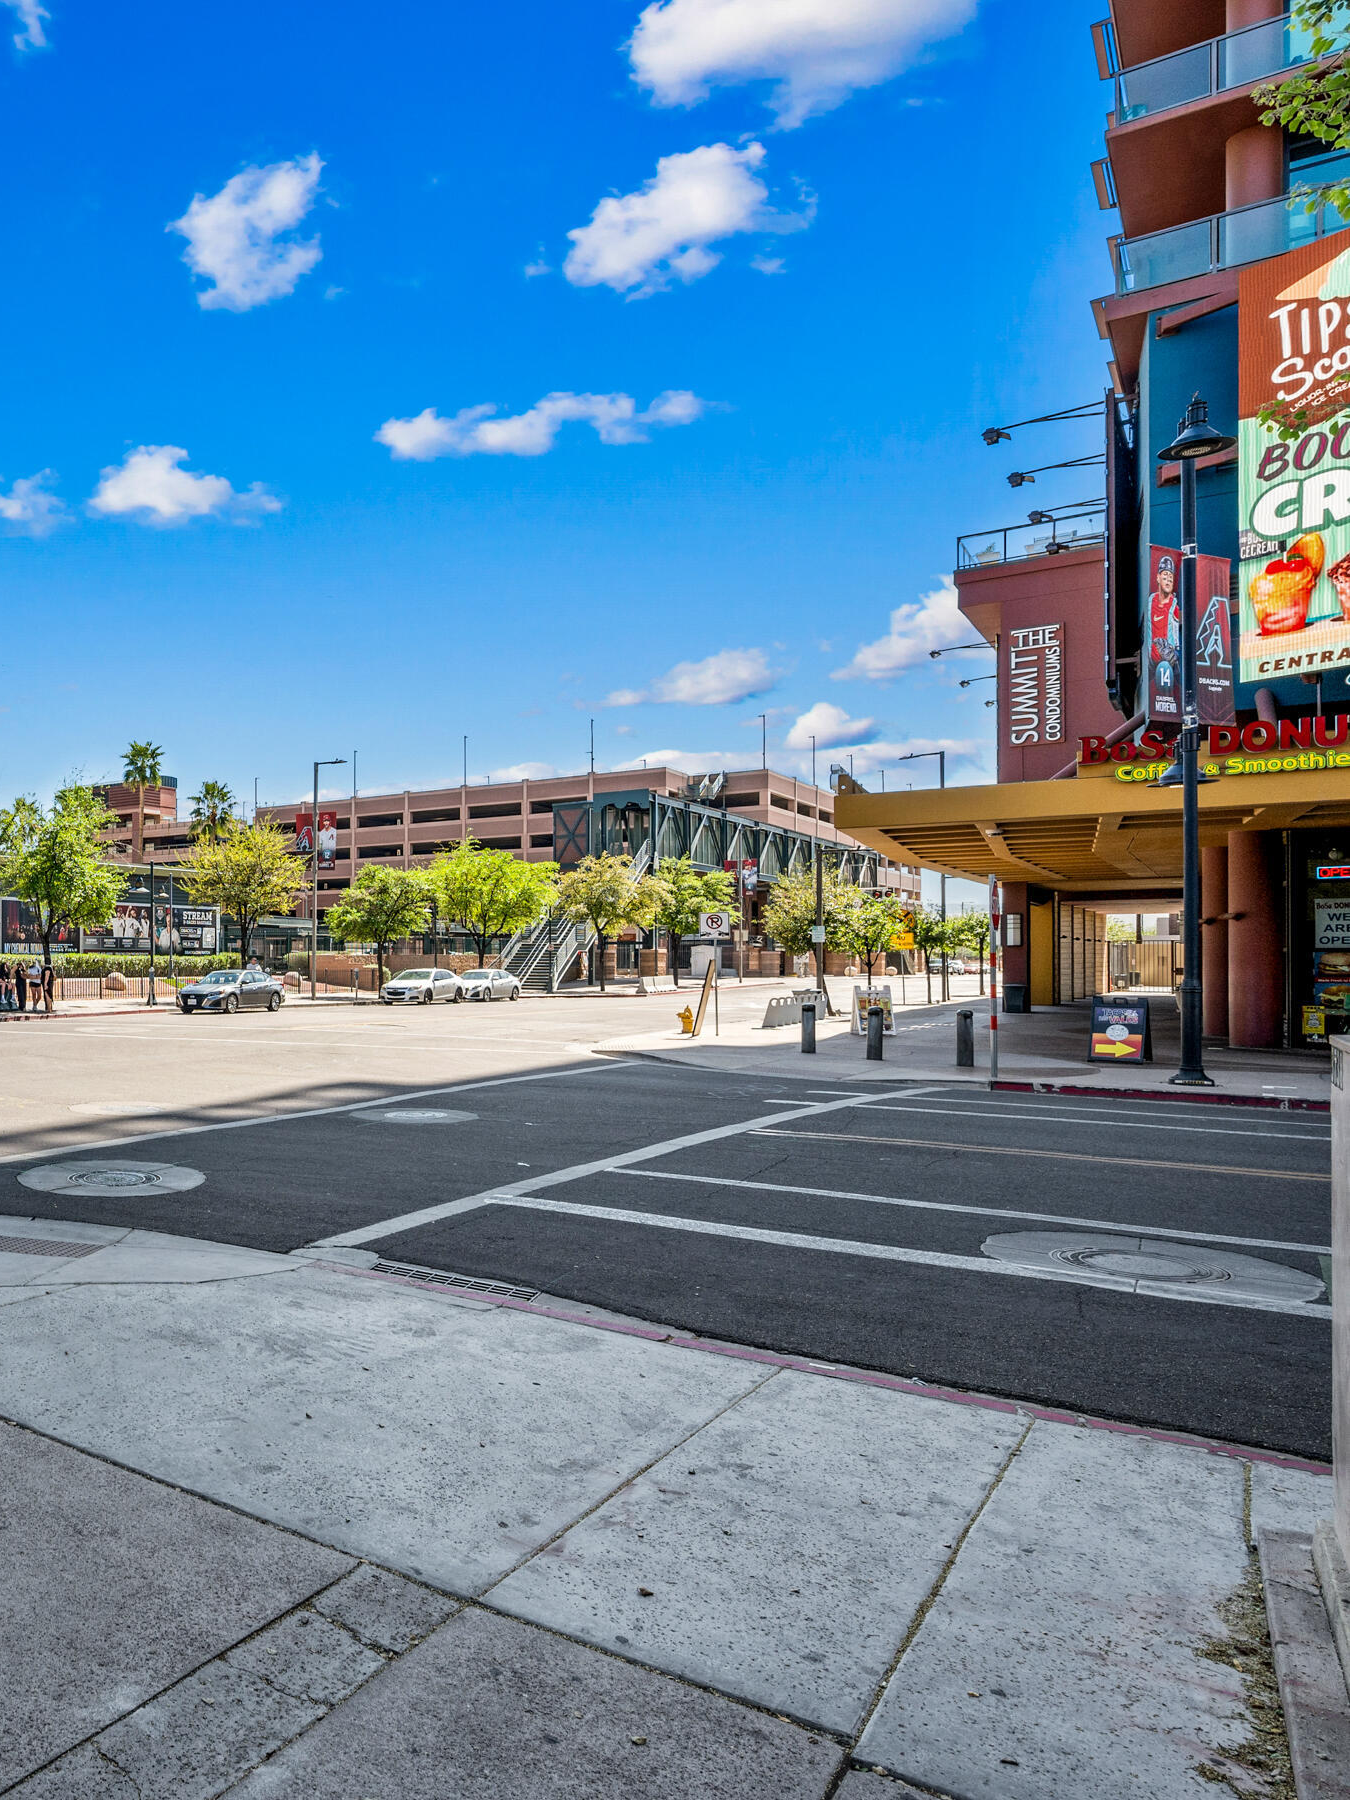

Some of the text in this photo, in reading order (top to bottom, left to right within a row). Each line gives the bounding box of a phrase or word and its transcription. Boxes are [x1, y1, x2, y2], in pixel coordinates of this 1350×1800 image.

[1013, 627, 1058, 648] THE
[1159, 667, 1171, 687] 14
[1010, 652, 1039, 745] SUMMIT
[1045, 646, 1061, 741] CONDOMINIUMS
[1155, 701, 1177, 713] MORENO
[1208, 713, 1350, 756] DONU
[1203, 764, 1220, 776] &
[182, 911, 212, 920] STREAM
[1328, 912, 1350, 921] WE
[1319, 936, 1350, 945] OPE
